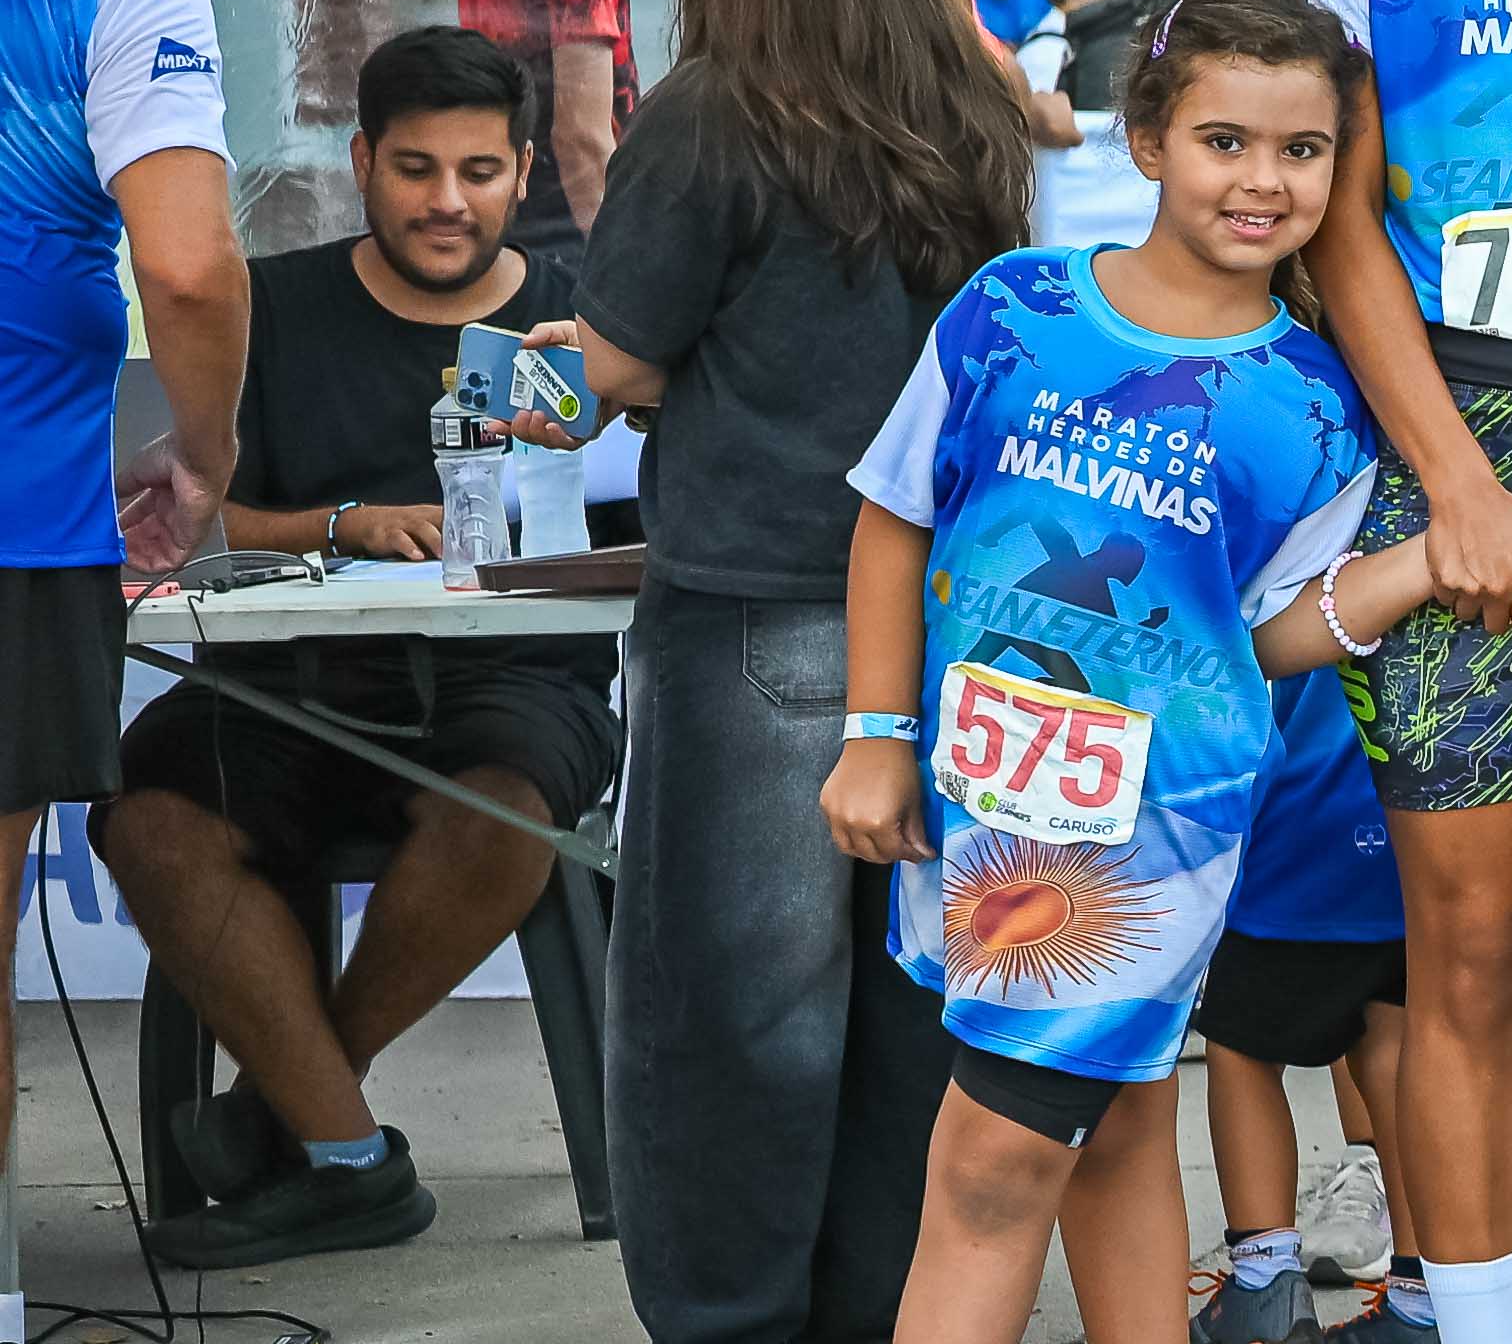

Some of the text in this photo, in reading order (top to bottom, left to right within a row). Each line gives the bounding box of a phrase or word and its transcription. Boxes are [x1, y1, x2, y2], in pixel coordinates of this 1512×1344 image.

[158, 53, 208, 70] MDXT
[1027, 413, 1207, 486] HÉROES DE
[1032, 389, 1217, 465] MARATÓN
[996, 435, 1218, 535] MALVINAS
[951, 676, 1128, 809] 575
[1048, 817, 1115, 836] CARUSO
